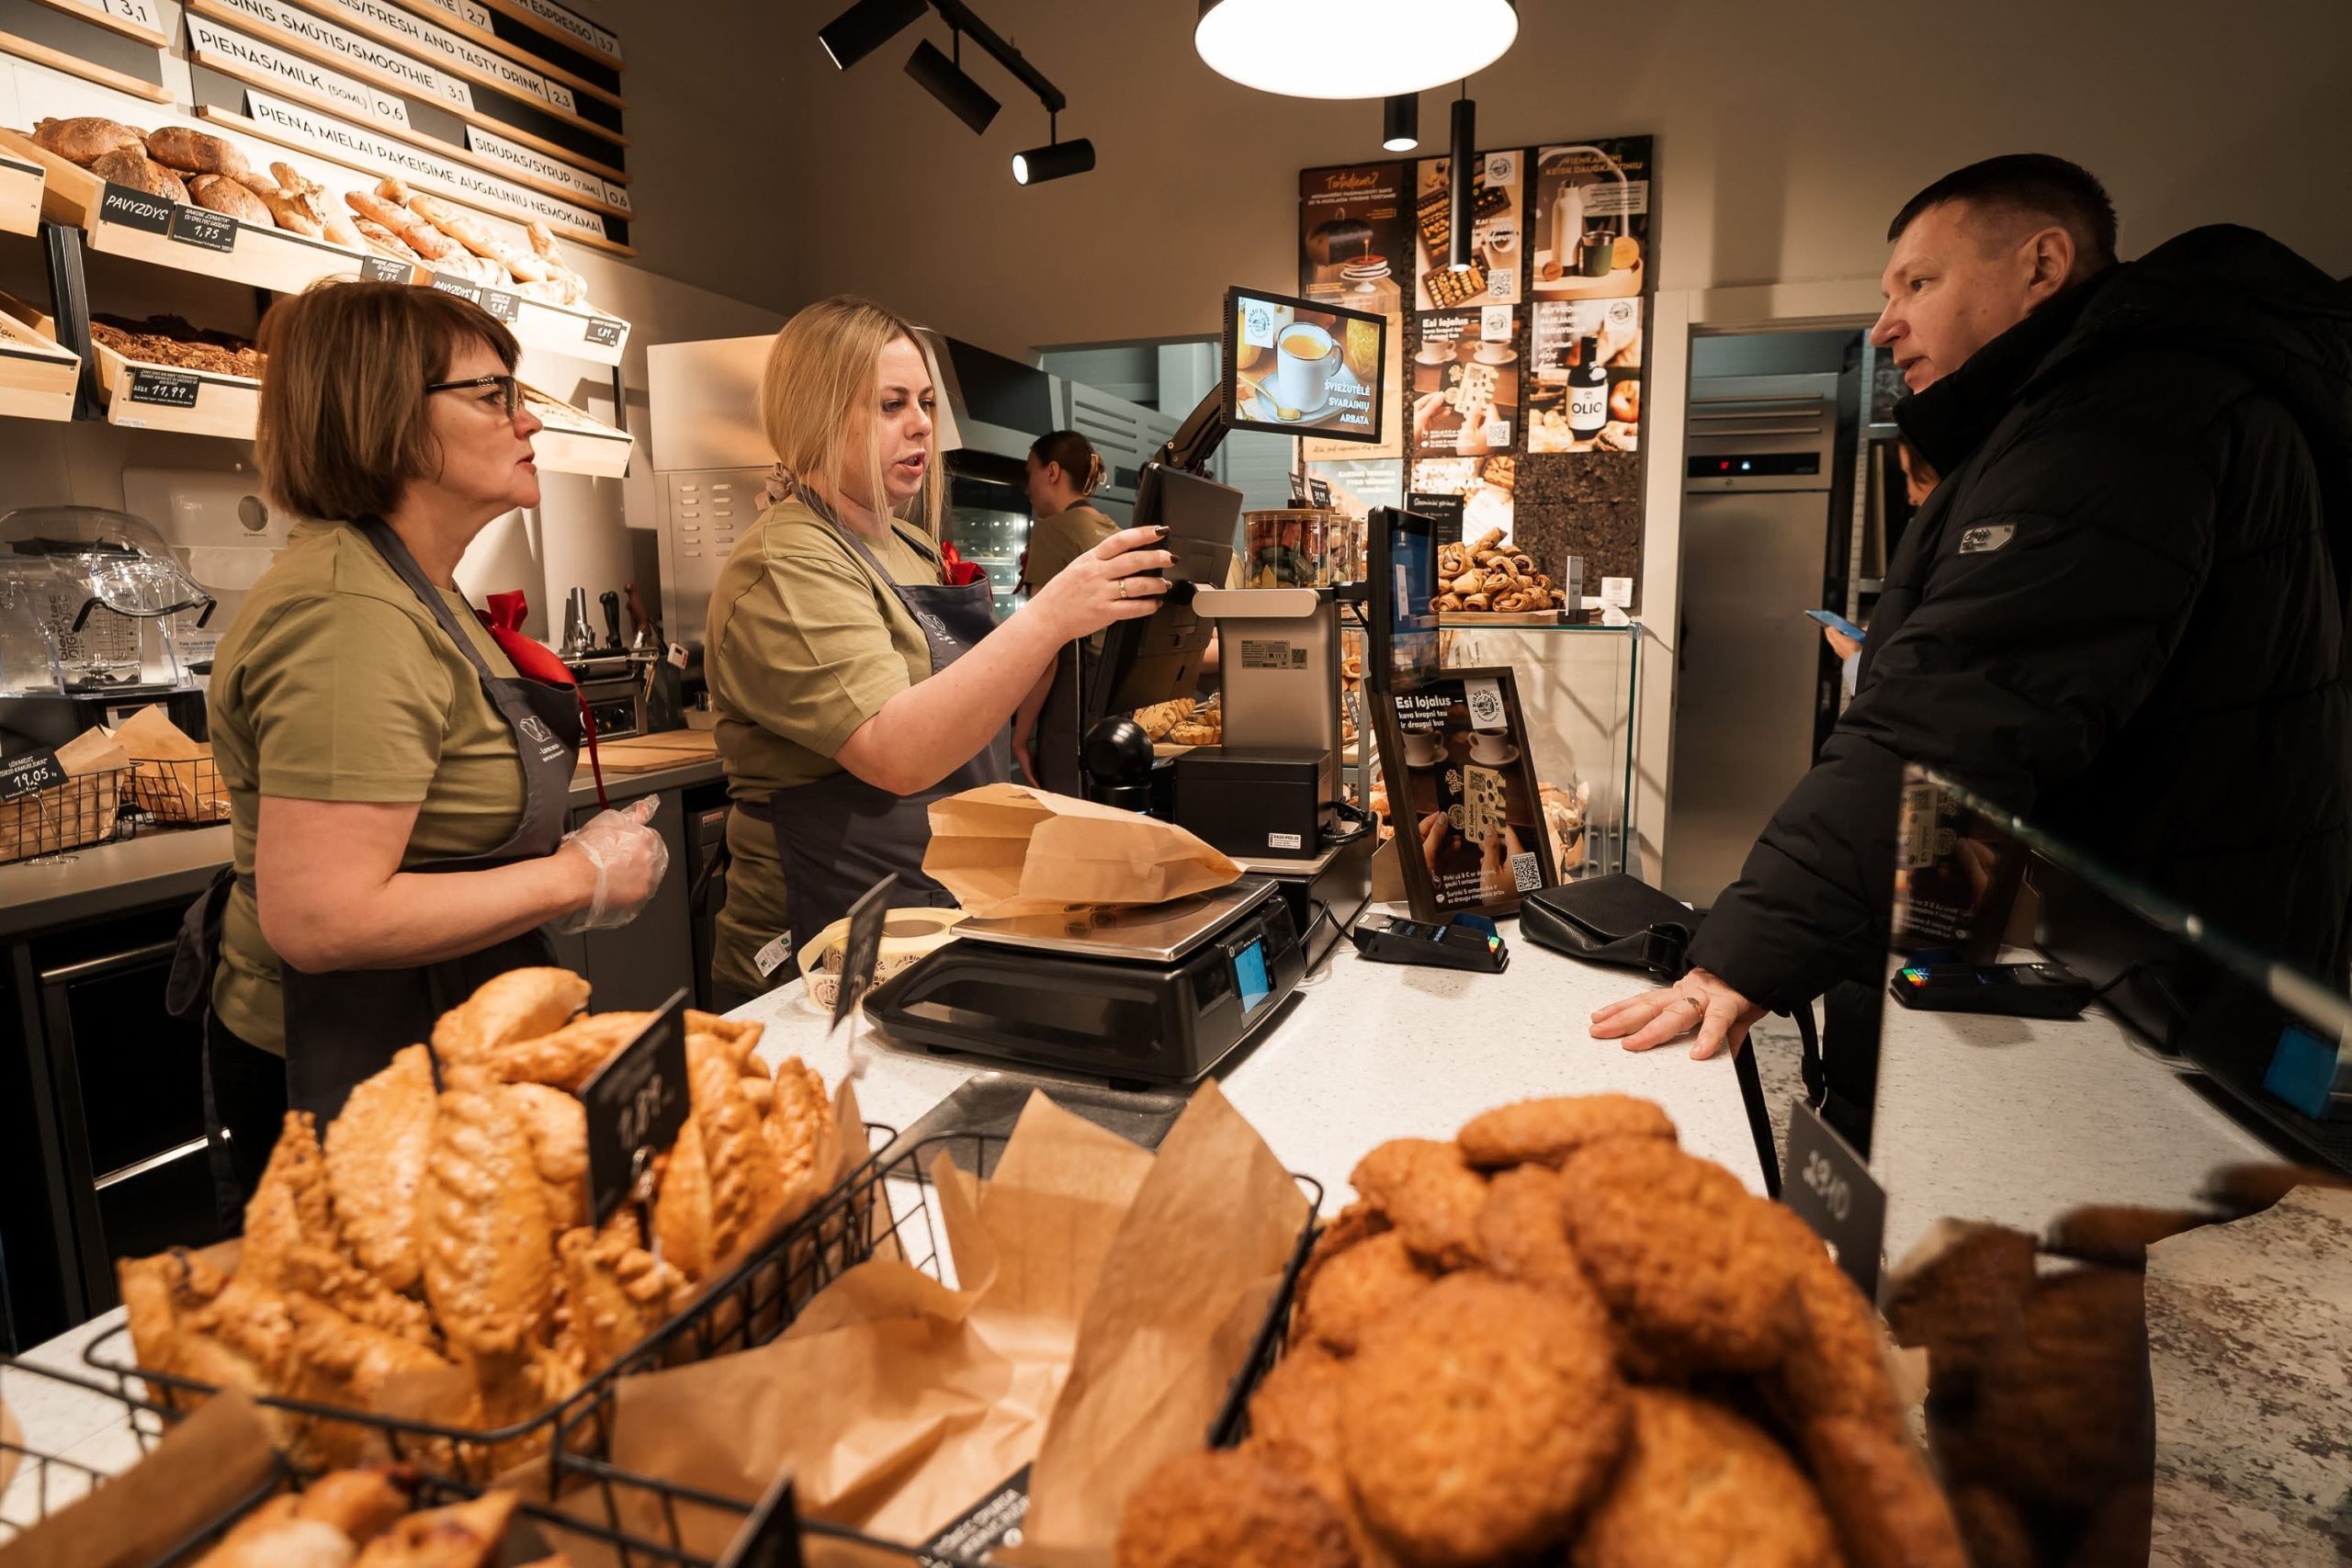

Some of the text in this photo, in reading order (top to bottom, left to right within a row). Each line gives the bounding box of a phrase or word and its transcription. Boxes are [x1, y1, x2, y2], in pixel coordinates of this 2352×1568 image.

[531, 0, 593, 41] ESPRESSO
[198, 28, 324, 90] PIENAS/MILK
[377, 100, 404, 121] 0,6
[424, 31, 455, 55] AND
[457, 46, 497, 74] TASTY
[501, 66, 543, 96] DRINK
[552, 90, 571, 108] 2,3
[319, 127, 373, 156] MIELAI
[377, 146, 456, 184] PAKEISIME
[474, 137, 571, 183] SIRUPAS/SYRUP
[106, 195, 169, 221] PAVYZDYS
[195, 225, 220, 240] 1,75
[152, 384, 187, 399] 11,99
[1324, 378, 1371, 397] ŠVIEŽUTĖLĖ
[1329, 397, 1370, 412] SVARAINIŲ
[1571, 401, 1603, 414] OLIO
[1340, 412, 1370, 426] ARBATA
[1395, 696, 1413, 709] Esi
[1415, 694, 1452, 710] lojalus
[1398, 709, 1448, 719] kava kvapni tau
[1408, 720, 1432, 729] draugui
[13, 767, 49, 788] 19,05
